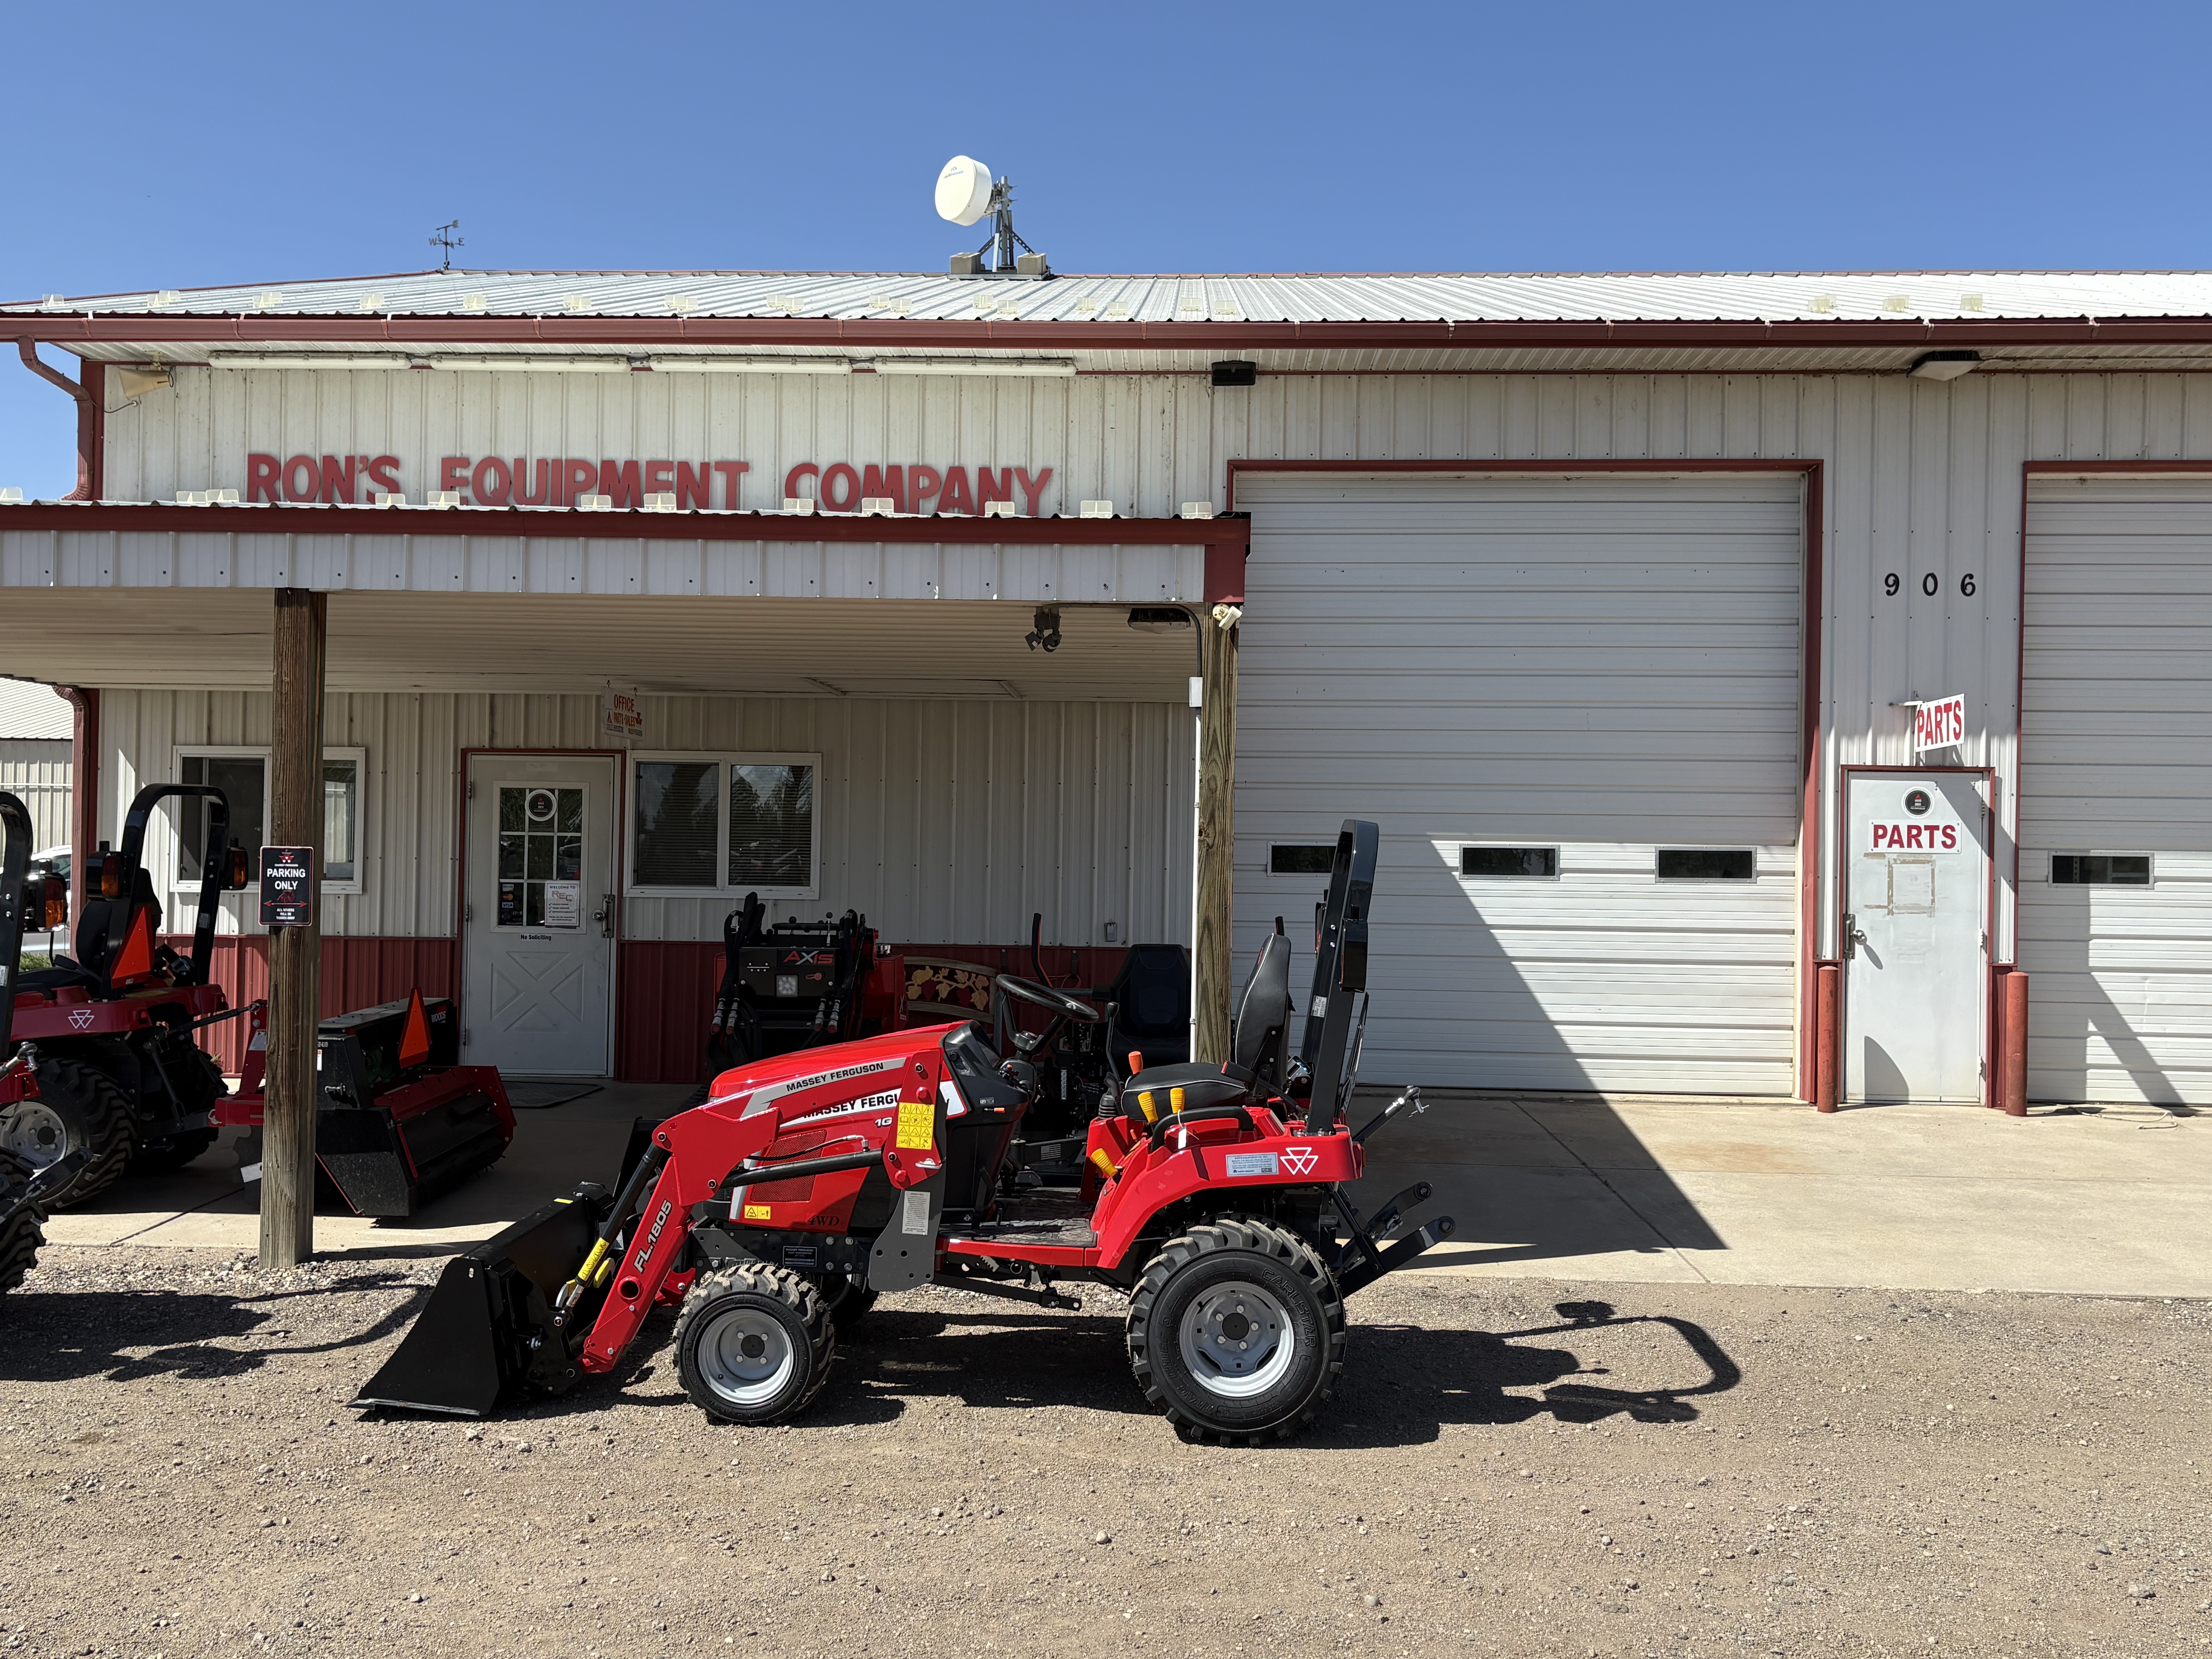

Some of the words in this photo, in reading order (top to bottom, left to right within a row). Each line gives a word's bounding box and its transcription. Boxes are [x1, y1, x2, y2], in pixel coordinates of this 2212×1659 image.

[247, 454, 400, 504] RON'S
[441, 457, 749, 510] EQUIPMENT
[785, 463, 1053, 517] COMPANY
[1884, 572, 1976, 597] 906
[614, 694, 634, 712] OFFICE
[1917, 700, 1962, 747] PARTS
[1874, 824, 1956, 849] PARTS
[267, 868, 306, 878] PARKING
[275, 881, 298, 890] ONLY
[552, 891, 573, 901] REC
[783, 951, 834, 965] AXIS
[787, 1075, 826, 1092] MASSEY
[831, 1062, 884, 1080] FERGUSON
[807, 1214, 840, 1226] 4WD
[633, 1199, 672, 1274] FL.1805
[1262, 1267, 1317, 1348] CARLSTAR
